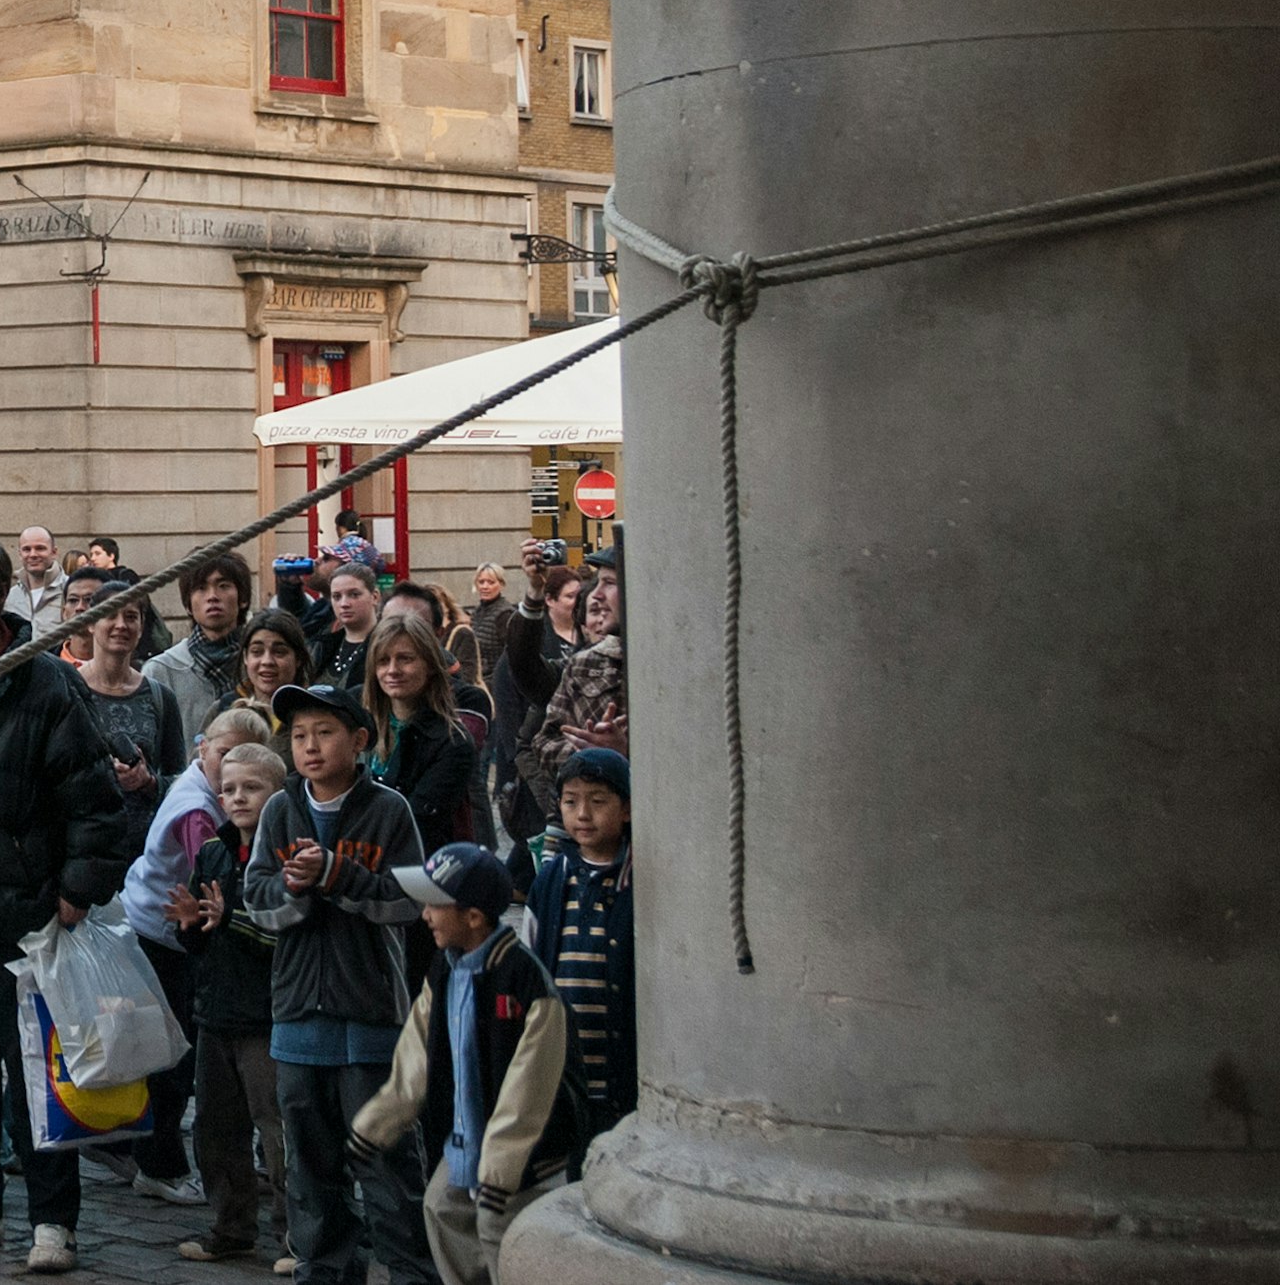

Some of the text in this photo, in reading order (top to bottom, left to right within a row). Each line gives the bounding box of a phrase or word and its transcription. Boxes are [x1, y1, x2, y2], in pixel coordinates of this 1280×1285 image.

[268, 287, 297, 306] BAR
[269, 425, 310, 442] pizza
[315, 425, 367, 440] pasta
[374, 424, 409, 440] vino
